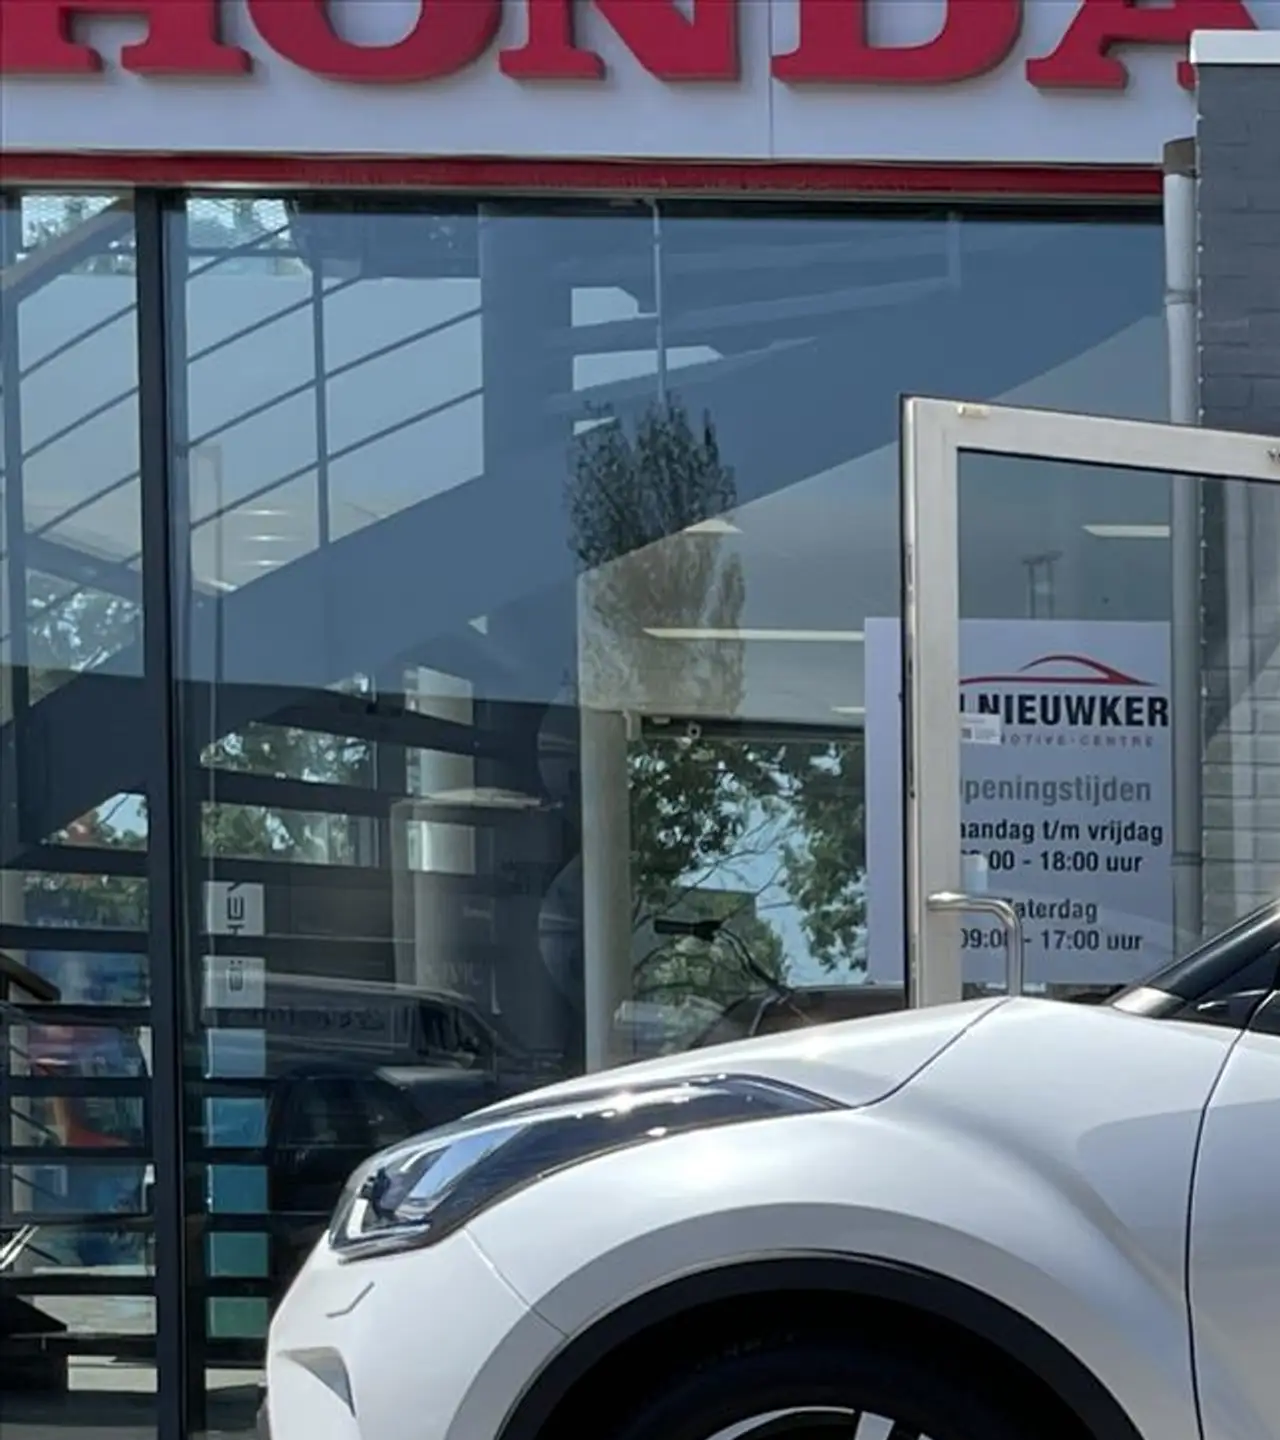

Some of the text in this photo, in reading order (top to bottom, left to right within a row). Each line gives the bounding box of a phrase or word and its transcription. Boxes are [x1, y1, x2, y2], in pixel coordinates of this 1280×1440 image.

[960, 774, 1151, 807] peningstijden
[1043, 819, 1080, 842] t/m
[1087, 820, 1164, 847] vrijdag
[1040, 850, 1100, 872] 18:00
[1106, 854, 1143, 873] uur
[1040, 929, 1100, 951] 17:00
[1106, 934, 1143, 950] uur
